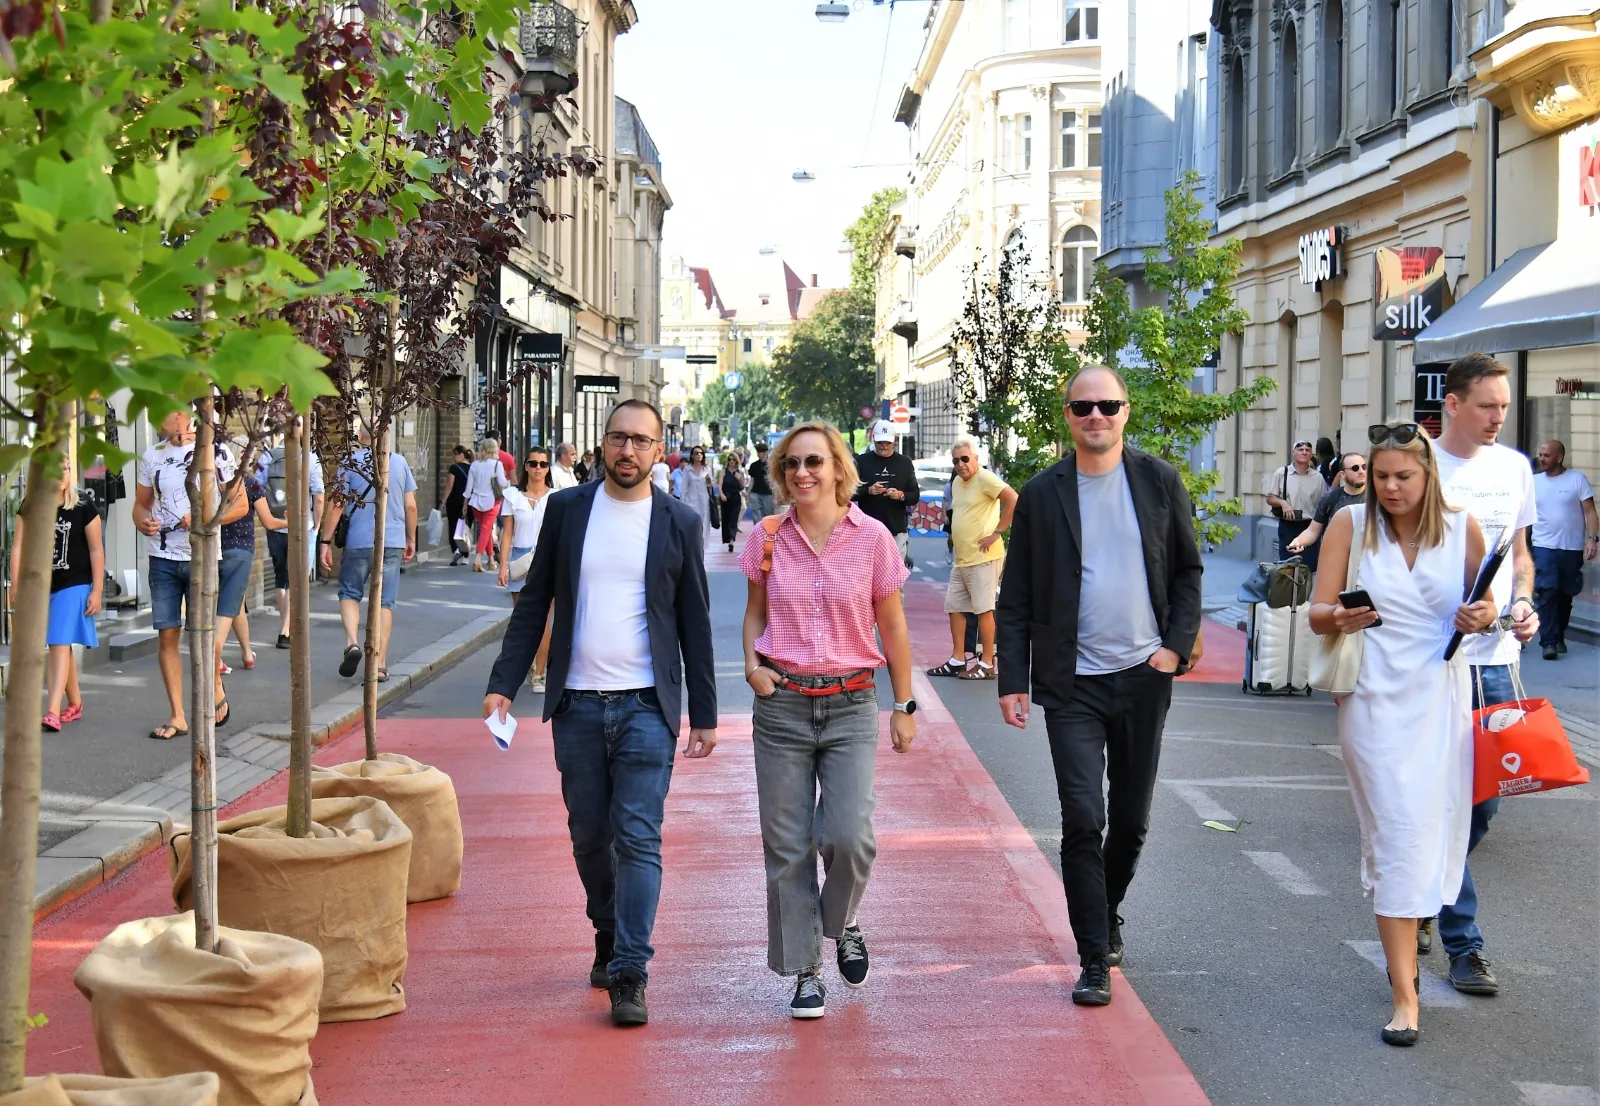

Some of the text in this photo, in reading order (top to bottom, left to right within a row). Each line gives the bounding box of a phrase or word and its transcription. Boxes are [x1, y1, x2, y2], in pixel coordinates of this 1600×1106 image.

[1385, 295, 1432, 335] silk
[523, 352, 560, 360] PARAMOUNT
[582, 385, 618, 393] DIESEL
[1501, 778, 1530, 790] ZAGREB
